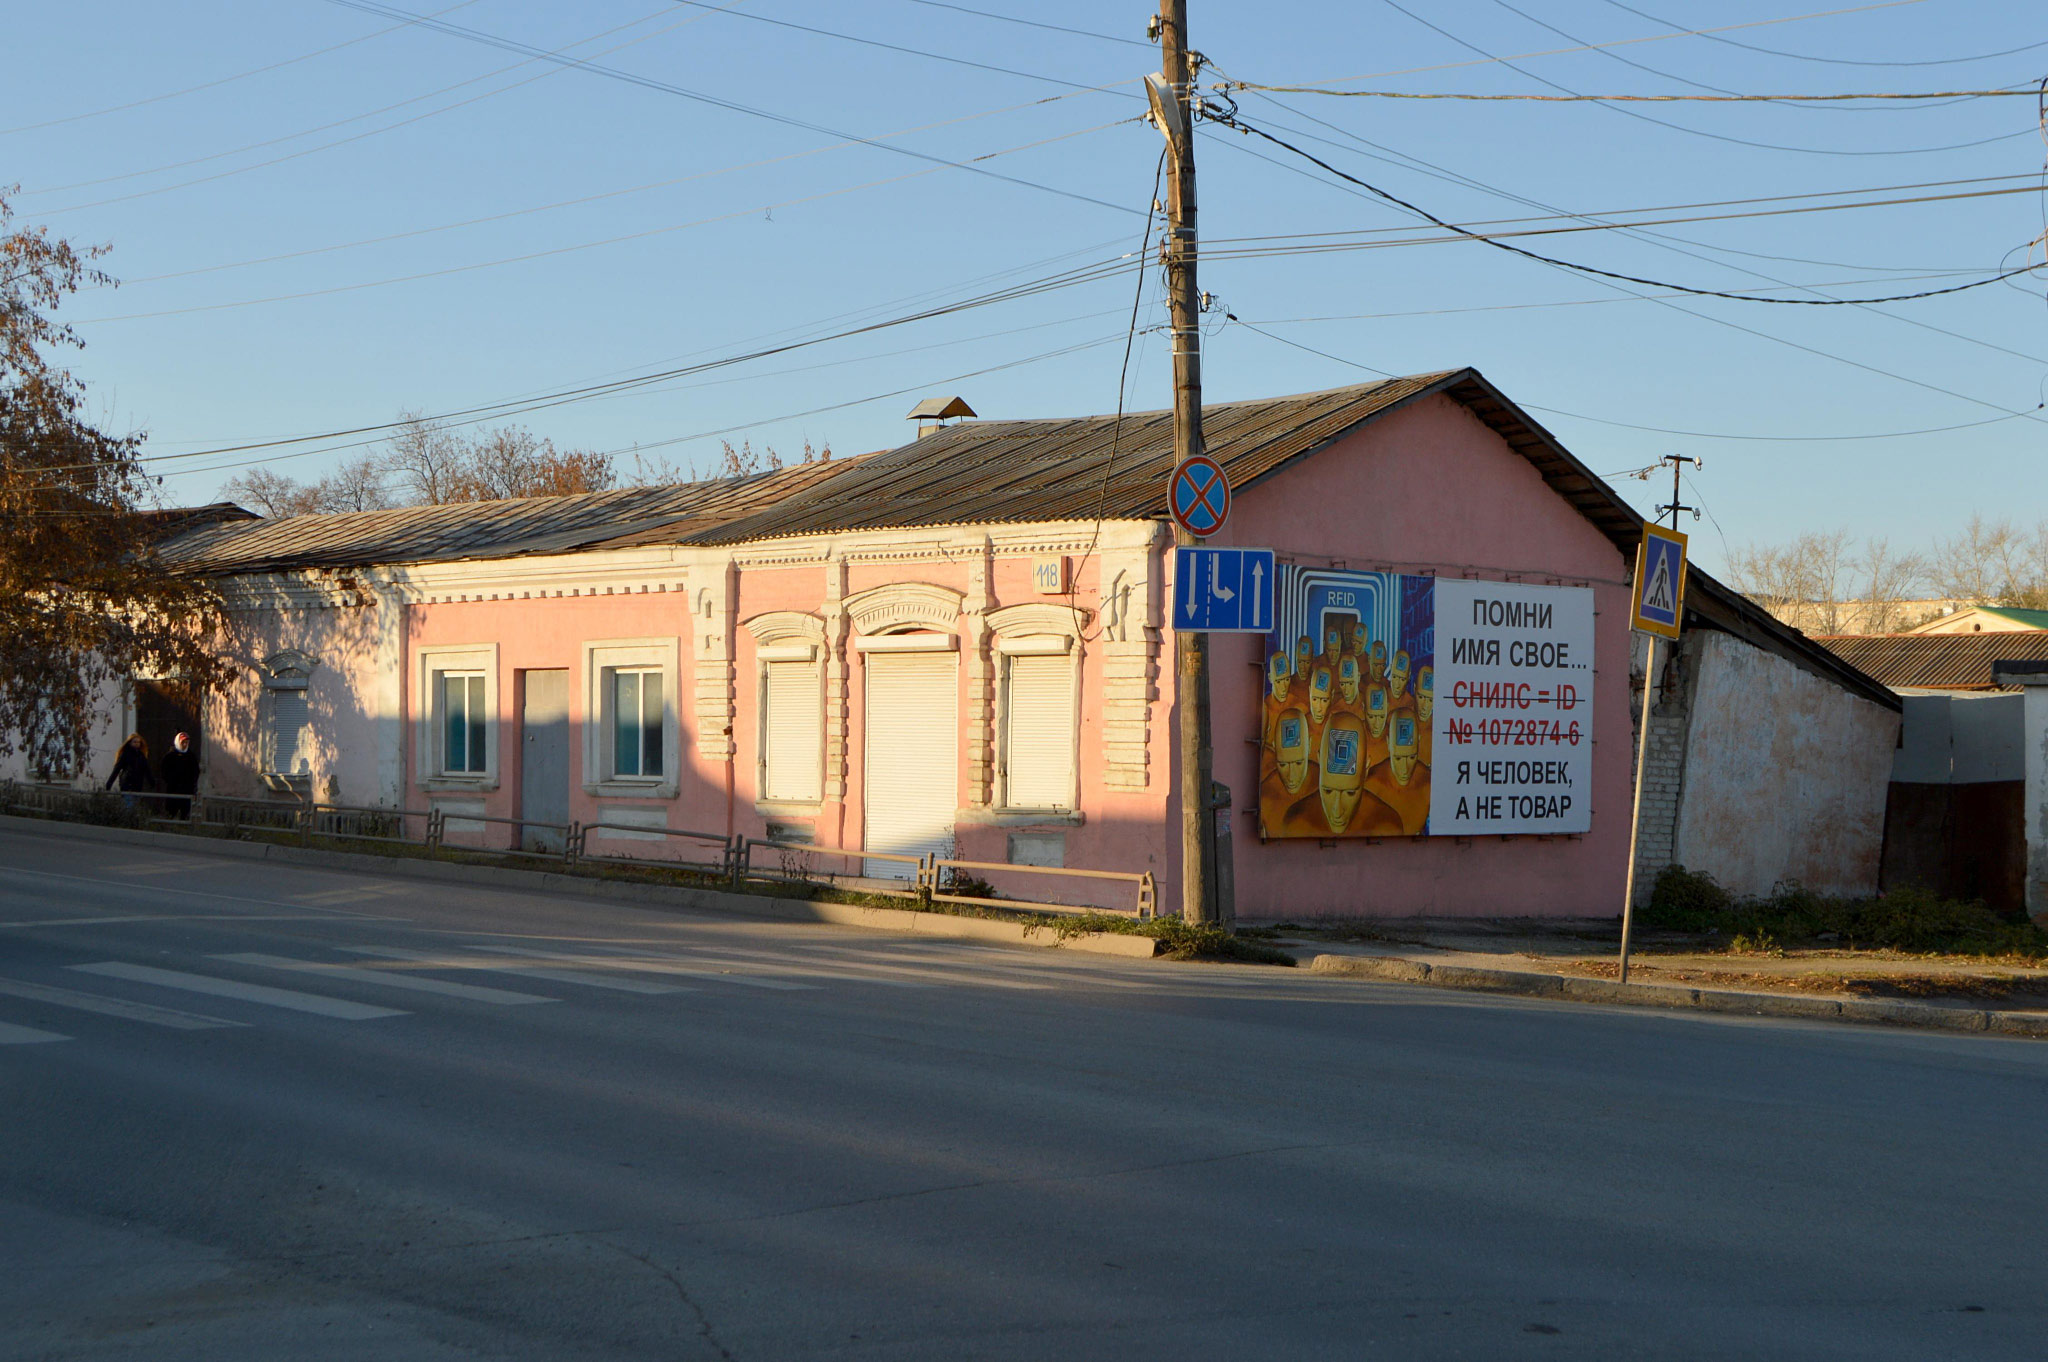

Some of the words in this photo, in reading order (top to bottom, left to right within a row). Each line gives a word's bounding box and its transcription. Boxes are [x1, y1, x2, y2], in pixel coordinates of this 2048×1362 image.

[1036, 563, 1058, 587] 118
[1327, 591, 1356, 607] RFID
[1473, 599, 1553, 629] ПОМНИ
[1452, 638, 1500, 666] ИМЯ
[1453, 680, 1531, 709] СНИЛС
[1557, 684, 1577, 710] ID
[1449, 718, 1473, 745] №
[1478, 718, 1580, 746] 1072874-6
[1456, 761, 1470, 785] Я
[1477, 761, 1573, 789] ЧЕЛОВЕК,
[1455, 796, 1470, 820] А
[1476, 796, 1502, 820] НЕ
[1508, 795, 1572, 820] ТОВАР
